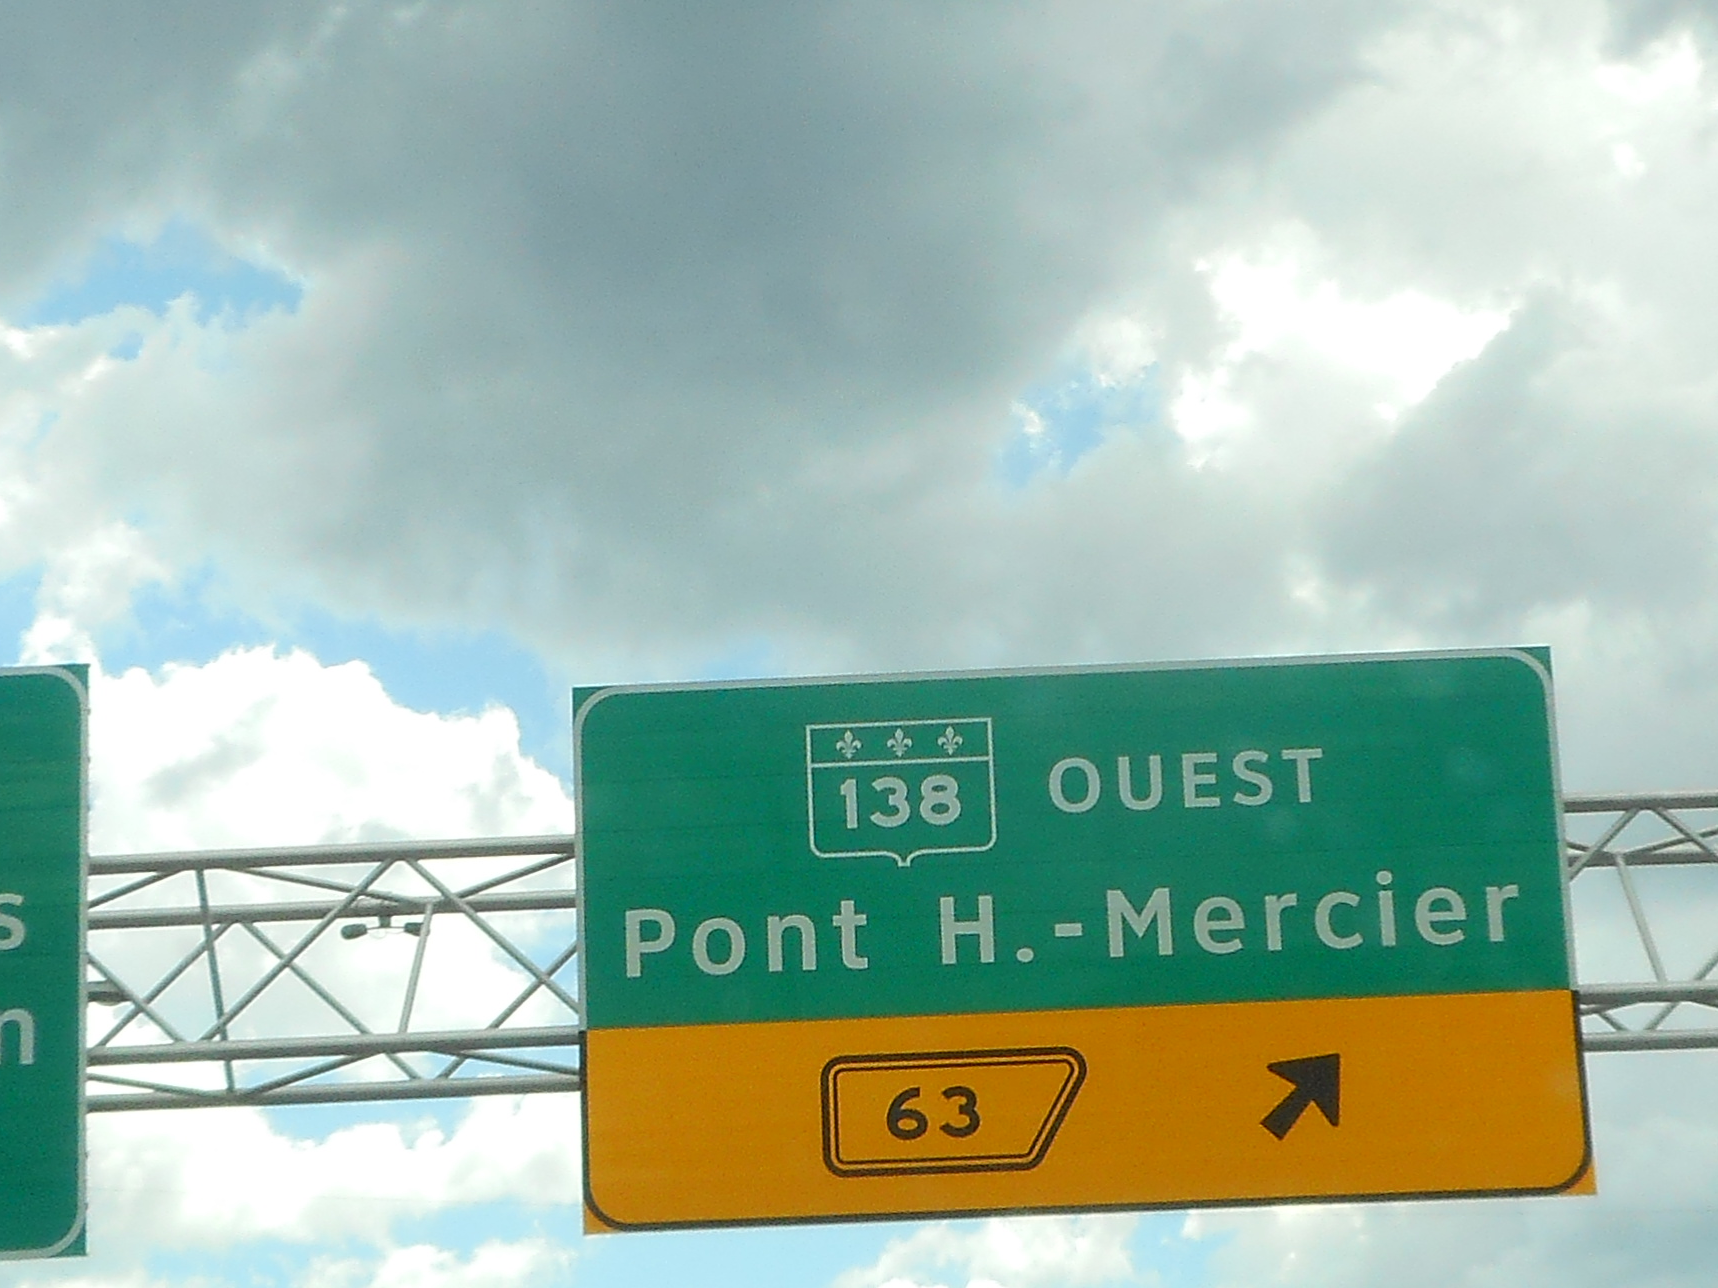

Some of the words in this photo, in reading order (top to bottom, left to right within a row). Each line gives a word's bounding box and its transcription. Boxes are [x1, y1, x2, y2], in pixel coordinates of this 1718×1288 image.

[839, 775, 962, 830] 138
[1049, 747, 1323, 813] OUEST
[625, 897, 869, 978] Pont
[940, 871, 1520, 964] H.-Mercier
[887, 1086, 980, 1141] 63
